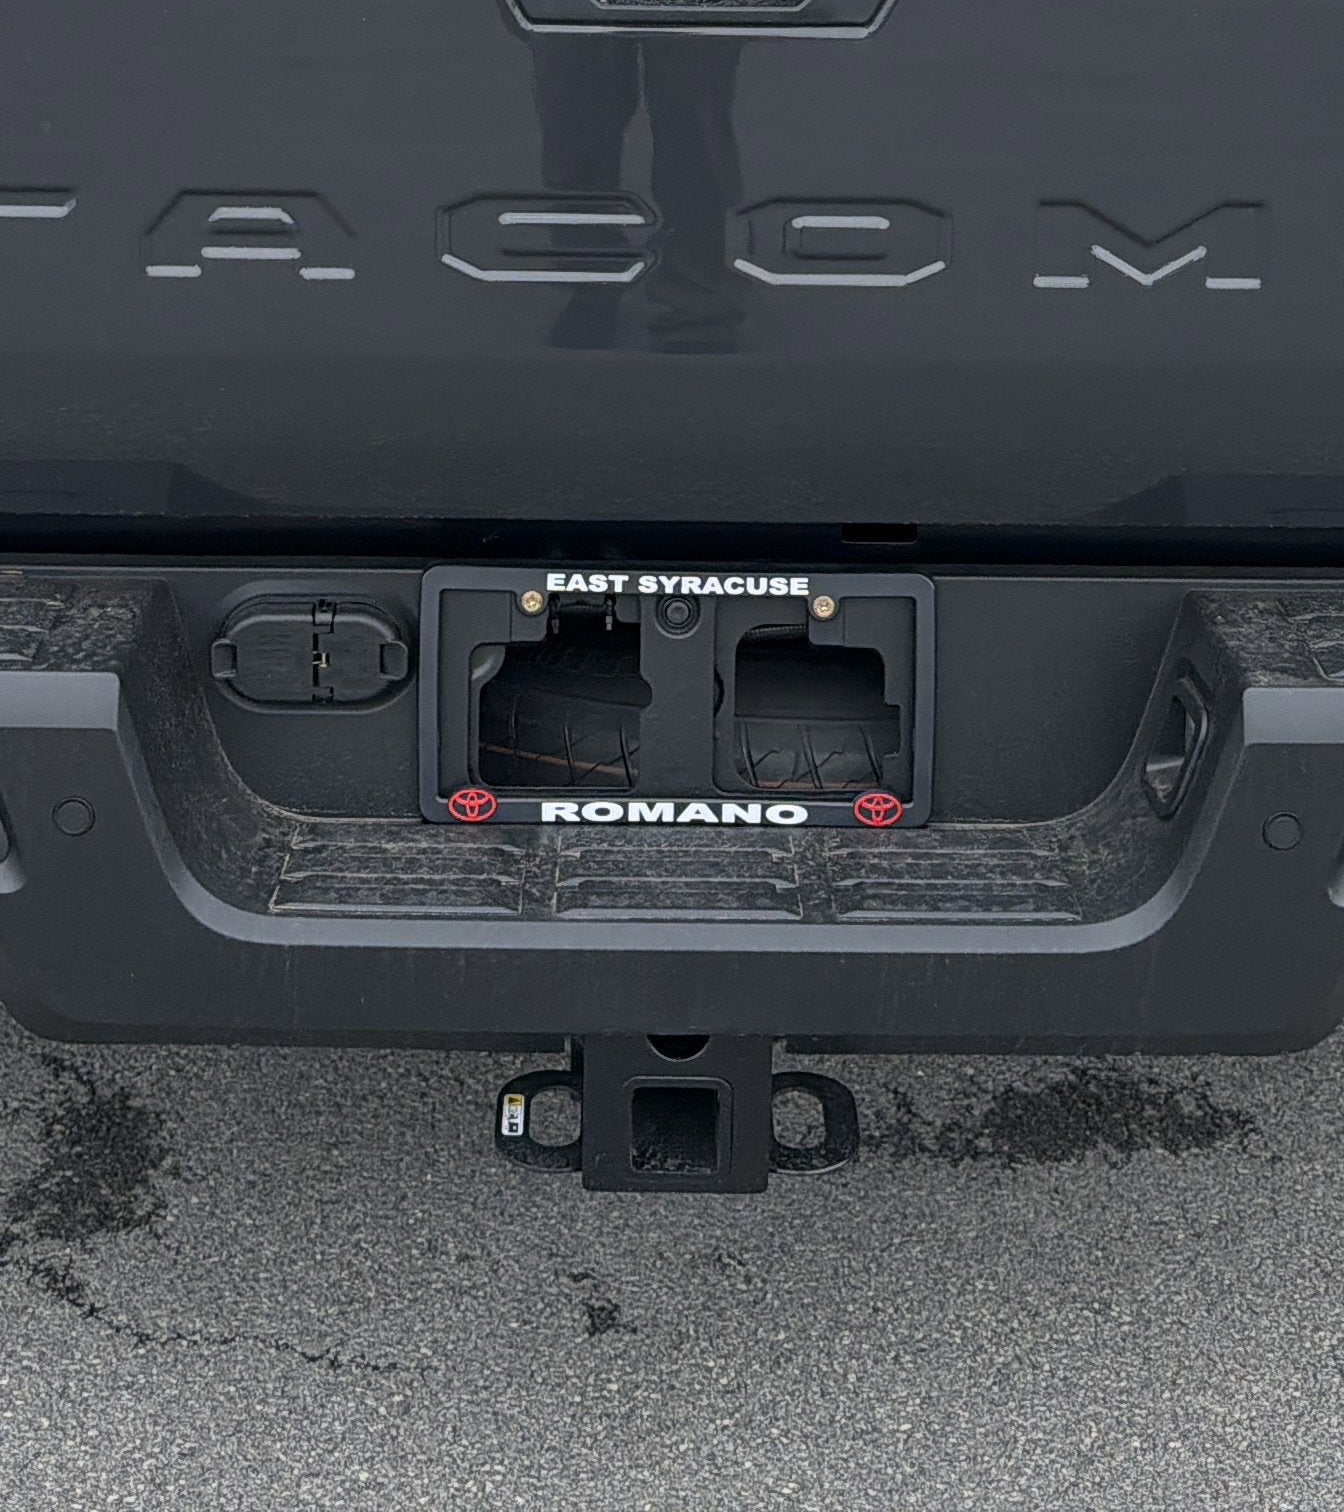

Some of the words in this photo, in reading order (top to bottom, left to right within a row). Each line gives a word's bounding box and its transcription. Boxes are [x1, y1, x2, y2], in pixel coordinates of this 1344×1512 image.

[546, 572, 630, 593] EAST
[638, 575, 810, 596] SYRACUSE
[541, 801, 809, 825] ROMANO
